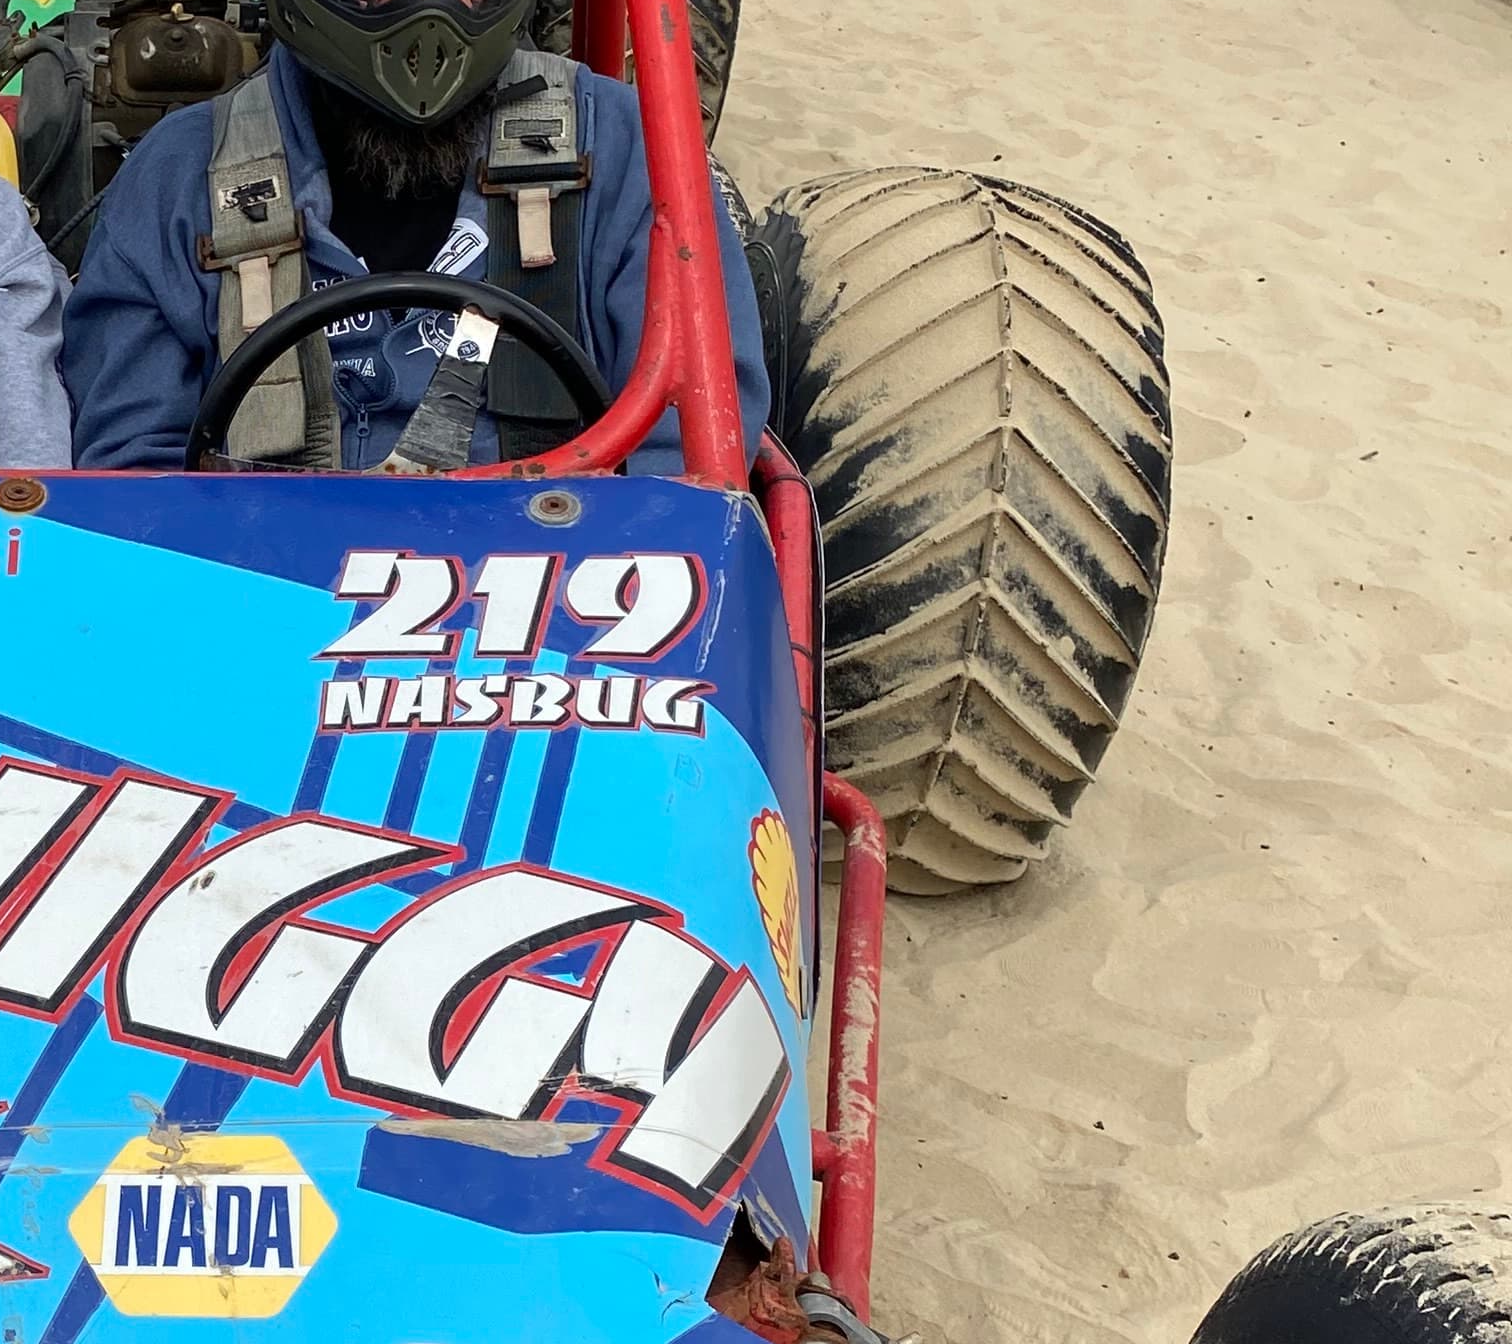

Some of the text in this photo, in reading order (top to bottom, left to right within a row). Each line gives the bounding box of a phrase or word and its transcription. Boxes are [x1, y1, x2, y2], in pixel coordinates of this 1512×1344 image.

[313, 550, 708, 662] 219
[320, 673, 717, 738] NASBUG
[114, 1184, 294, 1268] NADA
